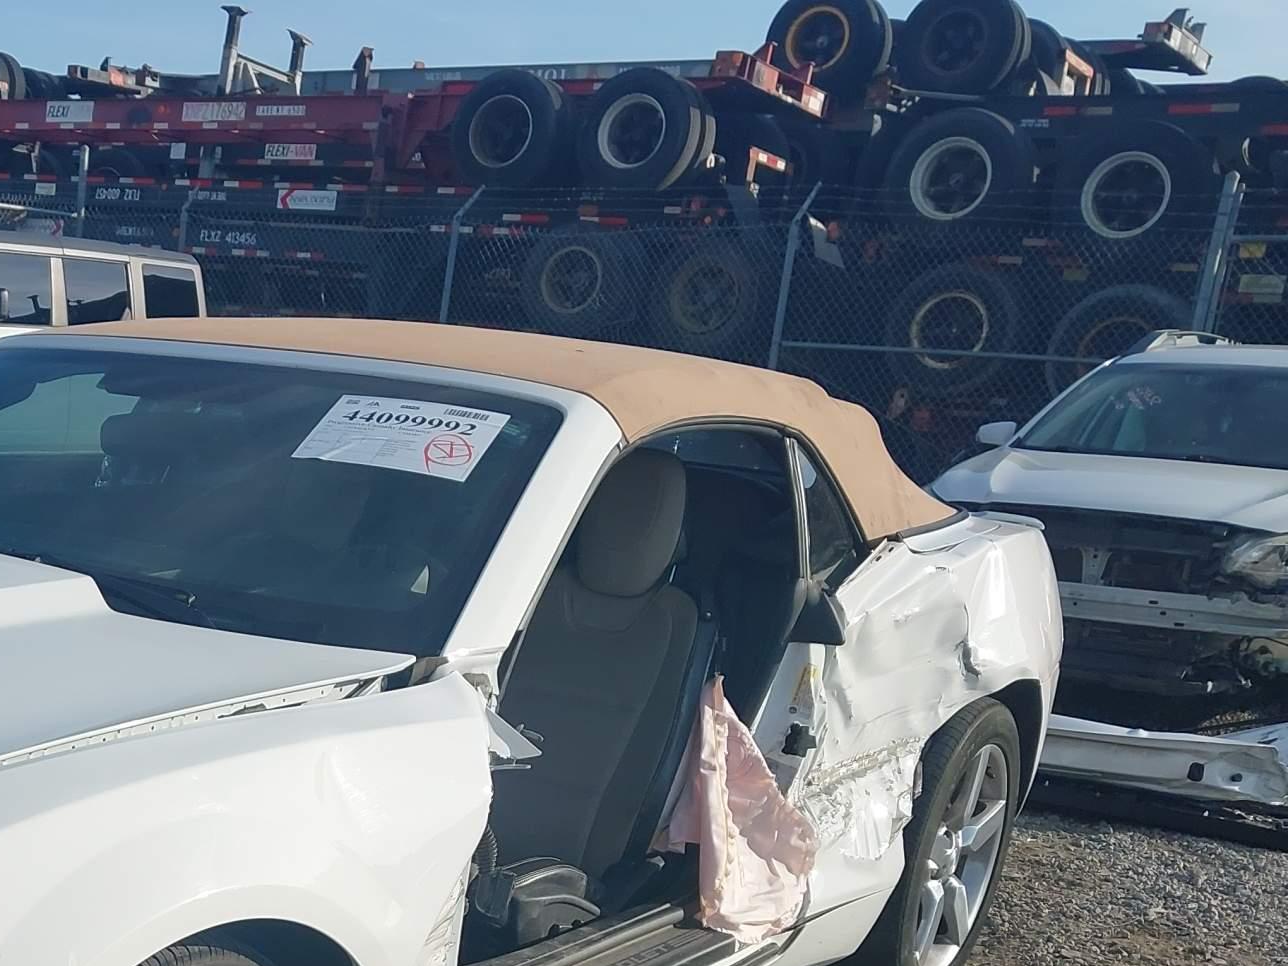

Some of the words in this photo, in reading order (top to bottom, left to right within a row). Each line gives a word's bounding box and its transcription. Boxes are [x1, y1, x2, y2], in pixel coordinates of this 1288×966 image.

[48, 104, 71, 118] FLEXI
[200, 229, 222, 242] FLXZ
[225, 231, 257, 245] 413456
[342, 409, 478, 436] 44099992
